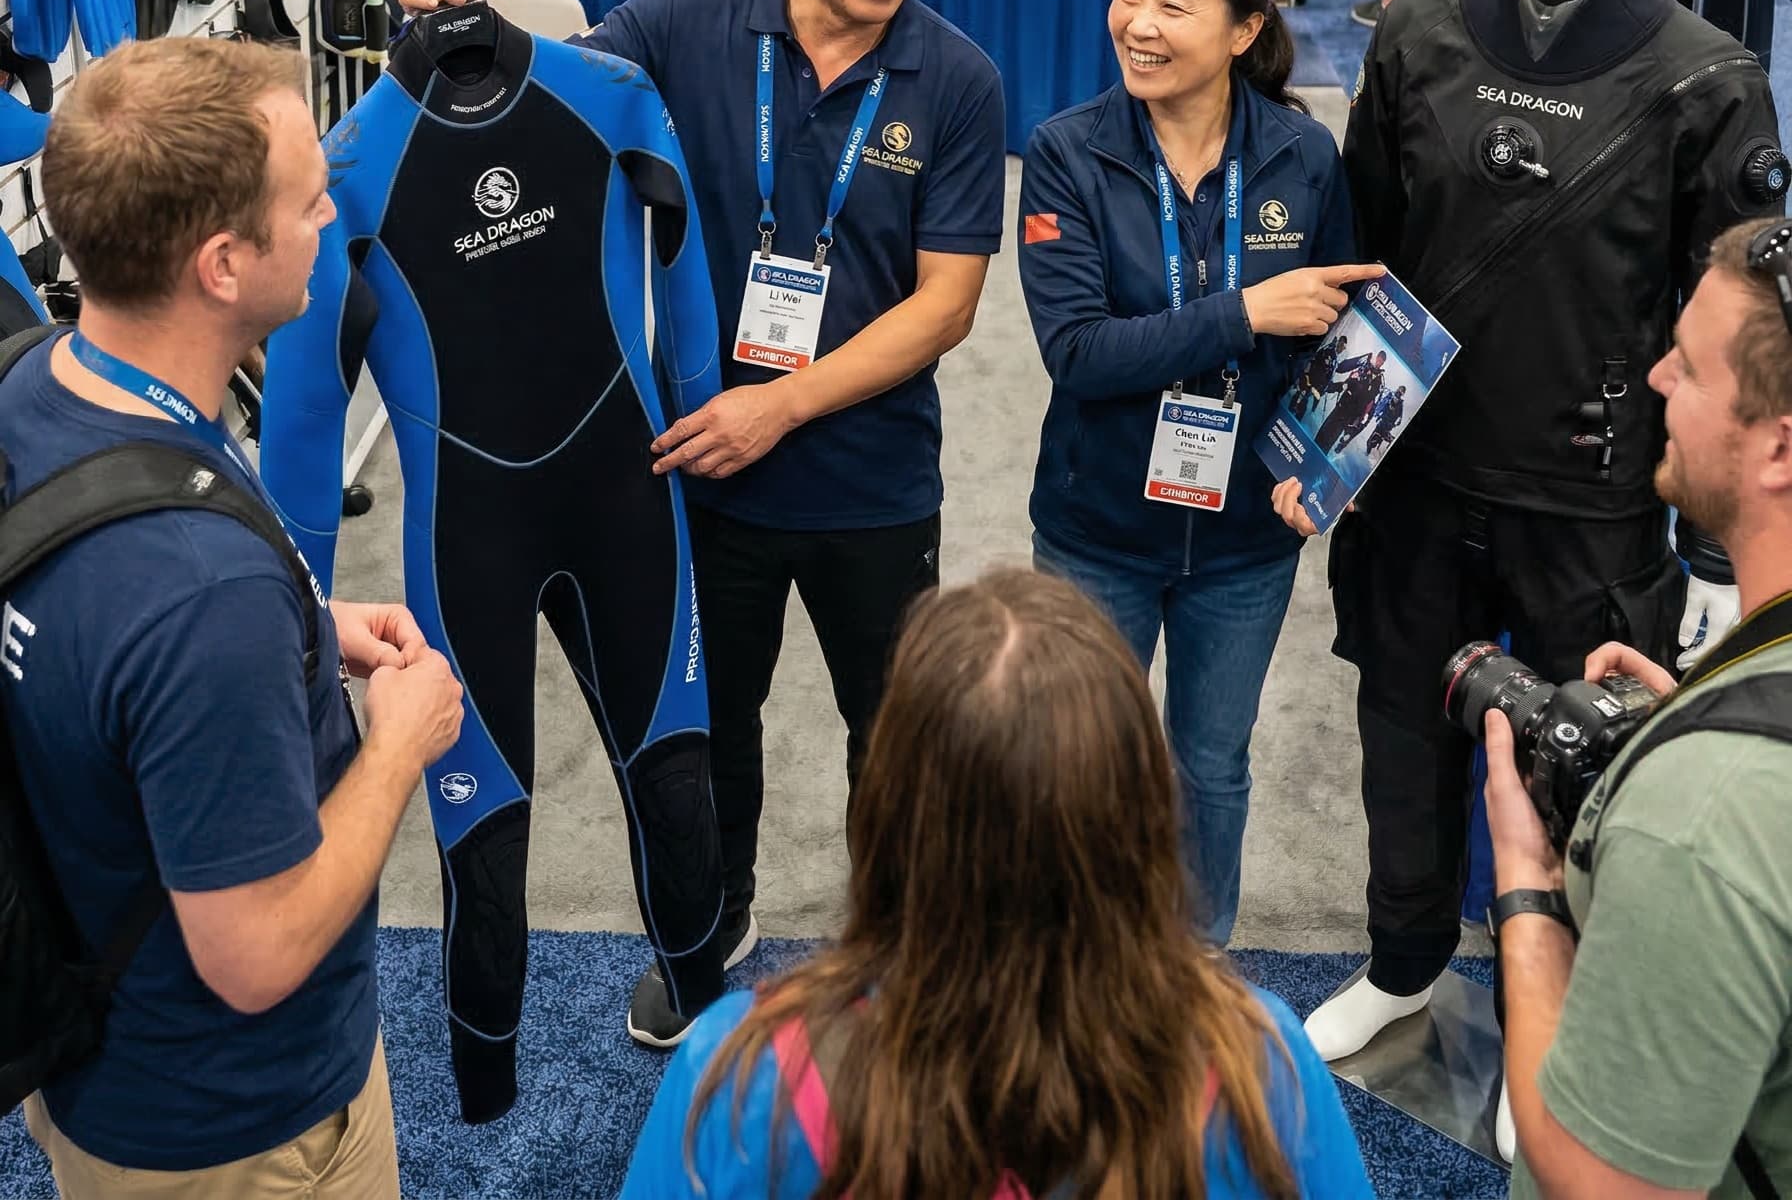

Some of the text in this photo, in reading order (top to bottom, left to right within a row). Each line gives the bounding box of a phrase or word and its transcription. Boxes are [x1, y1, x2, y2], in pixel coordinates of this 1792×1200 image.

[1476, 85, 1583, 120] SEA DRAGON
[454, 231, 485, 253] SEA
[487, 205, 555, 240] DRAGON
[1244, 232, 1304, 244] SEA DRAGON
[782, 291, 802, 304] Wei
[1175, 428, 1199, 441] Chen
